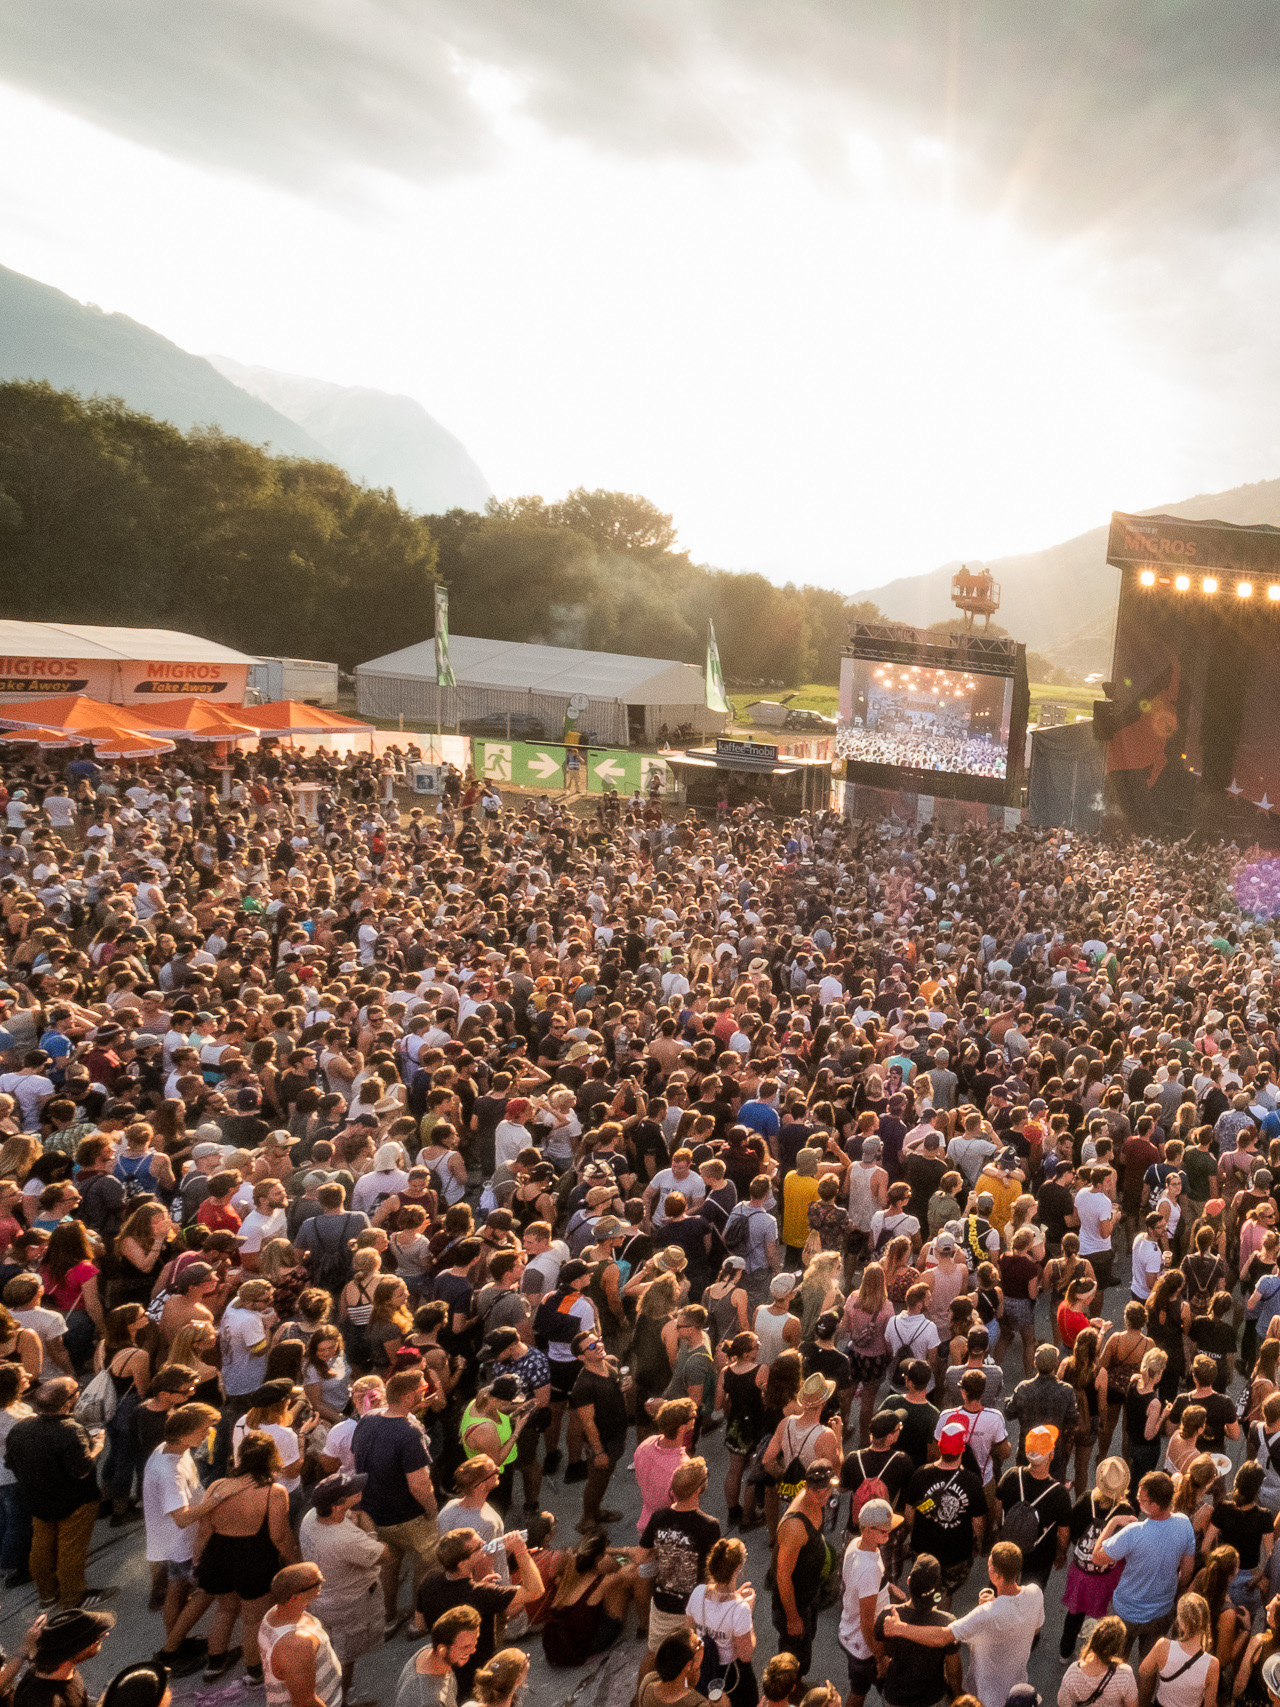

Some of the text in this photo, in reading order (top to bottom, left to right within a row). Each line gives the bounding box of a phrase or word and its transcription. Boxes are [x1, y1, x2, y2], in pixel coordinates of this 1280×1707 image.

[1124, 534, 1197, 557] MIGROS
[146, 663, 221, 679] MIGROS
[0, 679, 71, 692] ake Away
[151, 681, 215, 693] Take Away
